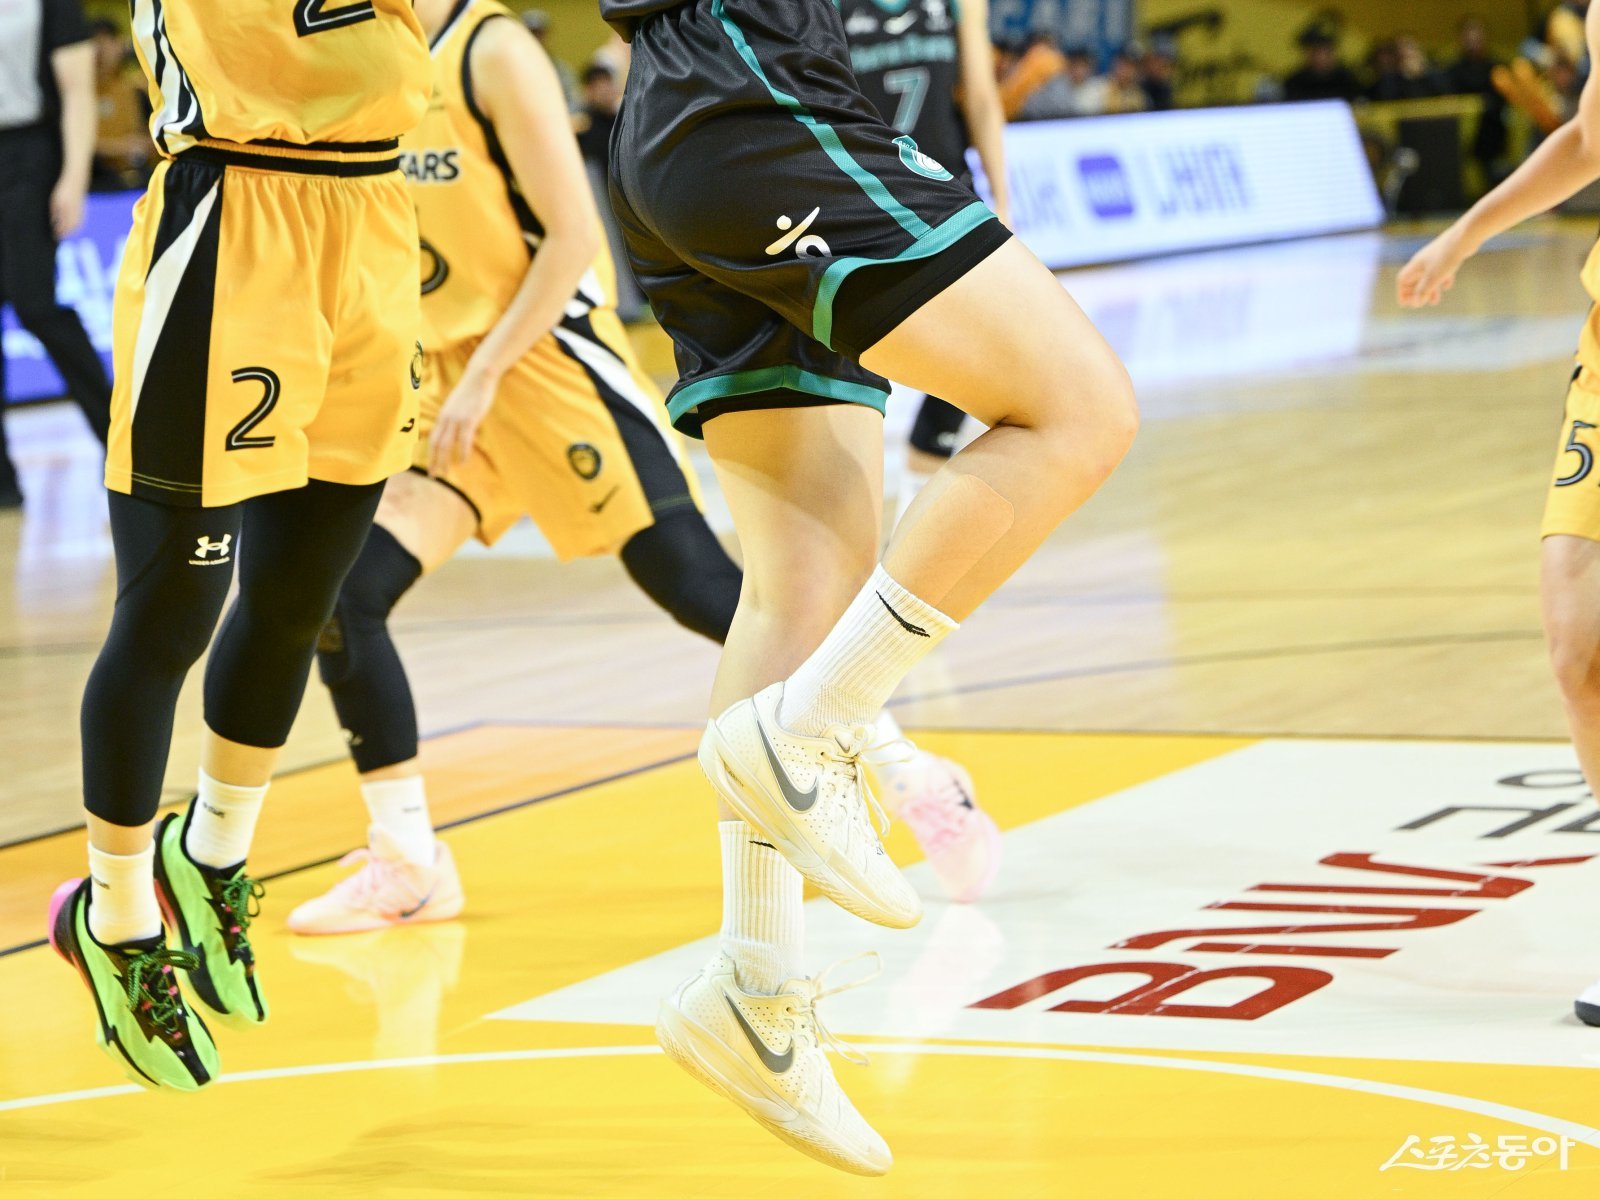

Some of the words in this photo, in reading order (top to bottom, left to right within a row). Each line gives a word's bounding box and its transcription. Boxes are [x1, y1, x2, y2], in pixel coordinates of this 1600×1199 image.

[883, 66, 930, 134] 7
[225, 366, 282, 452] 2
[1554, 420, 1597, 487] 5
